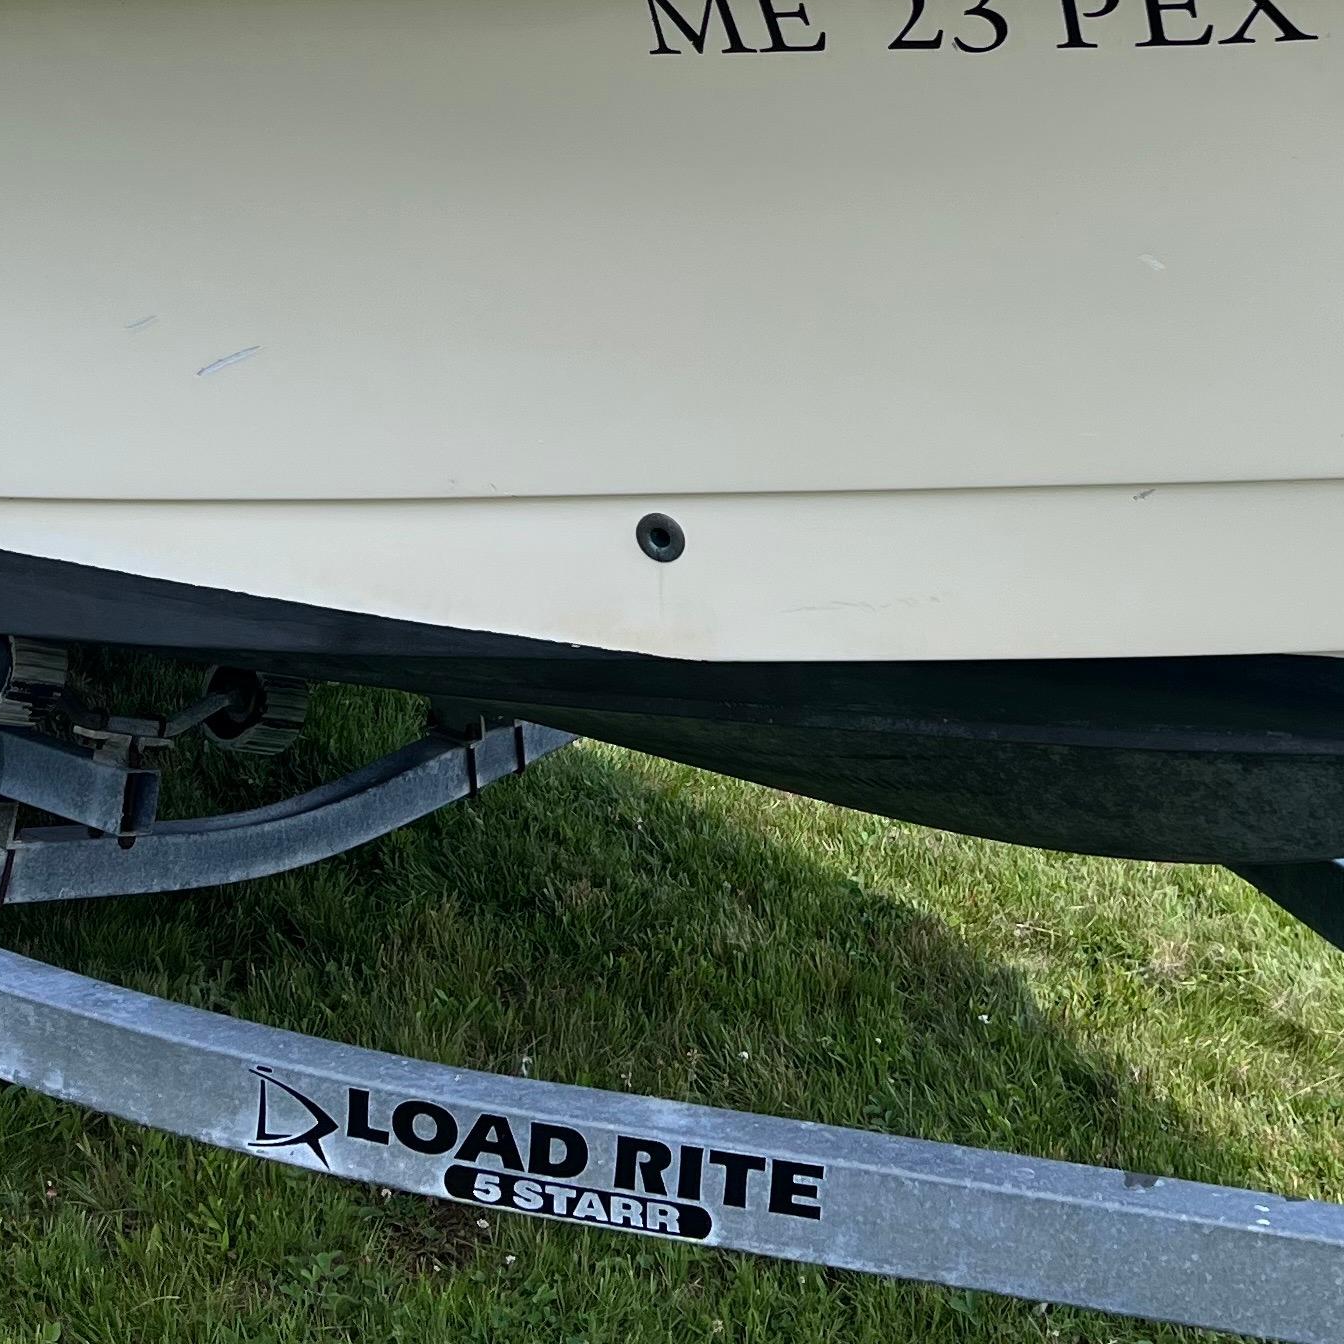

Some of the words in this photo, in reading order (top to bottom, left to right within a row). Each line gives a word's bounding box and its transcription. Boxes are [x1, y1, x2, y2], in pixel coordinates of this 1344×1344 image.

[346, 1087, 590, 1179] LOAD
[613, 1135, 825, 1221] RITE
[472, 1173, 503, 1203] 5
[512, 1180, 681, 1235] STARR
